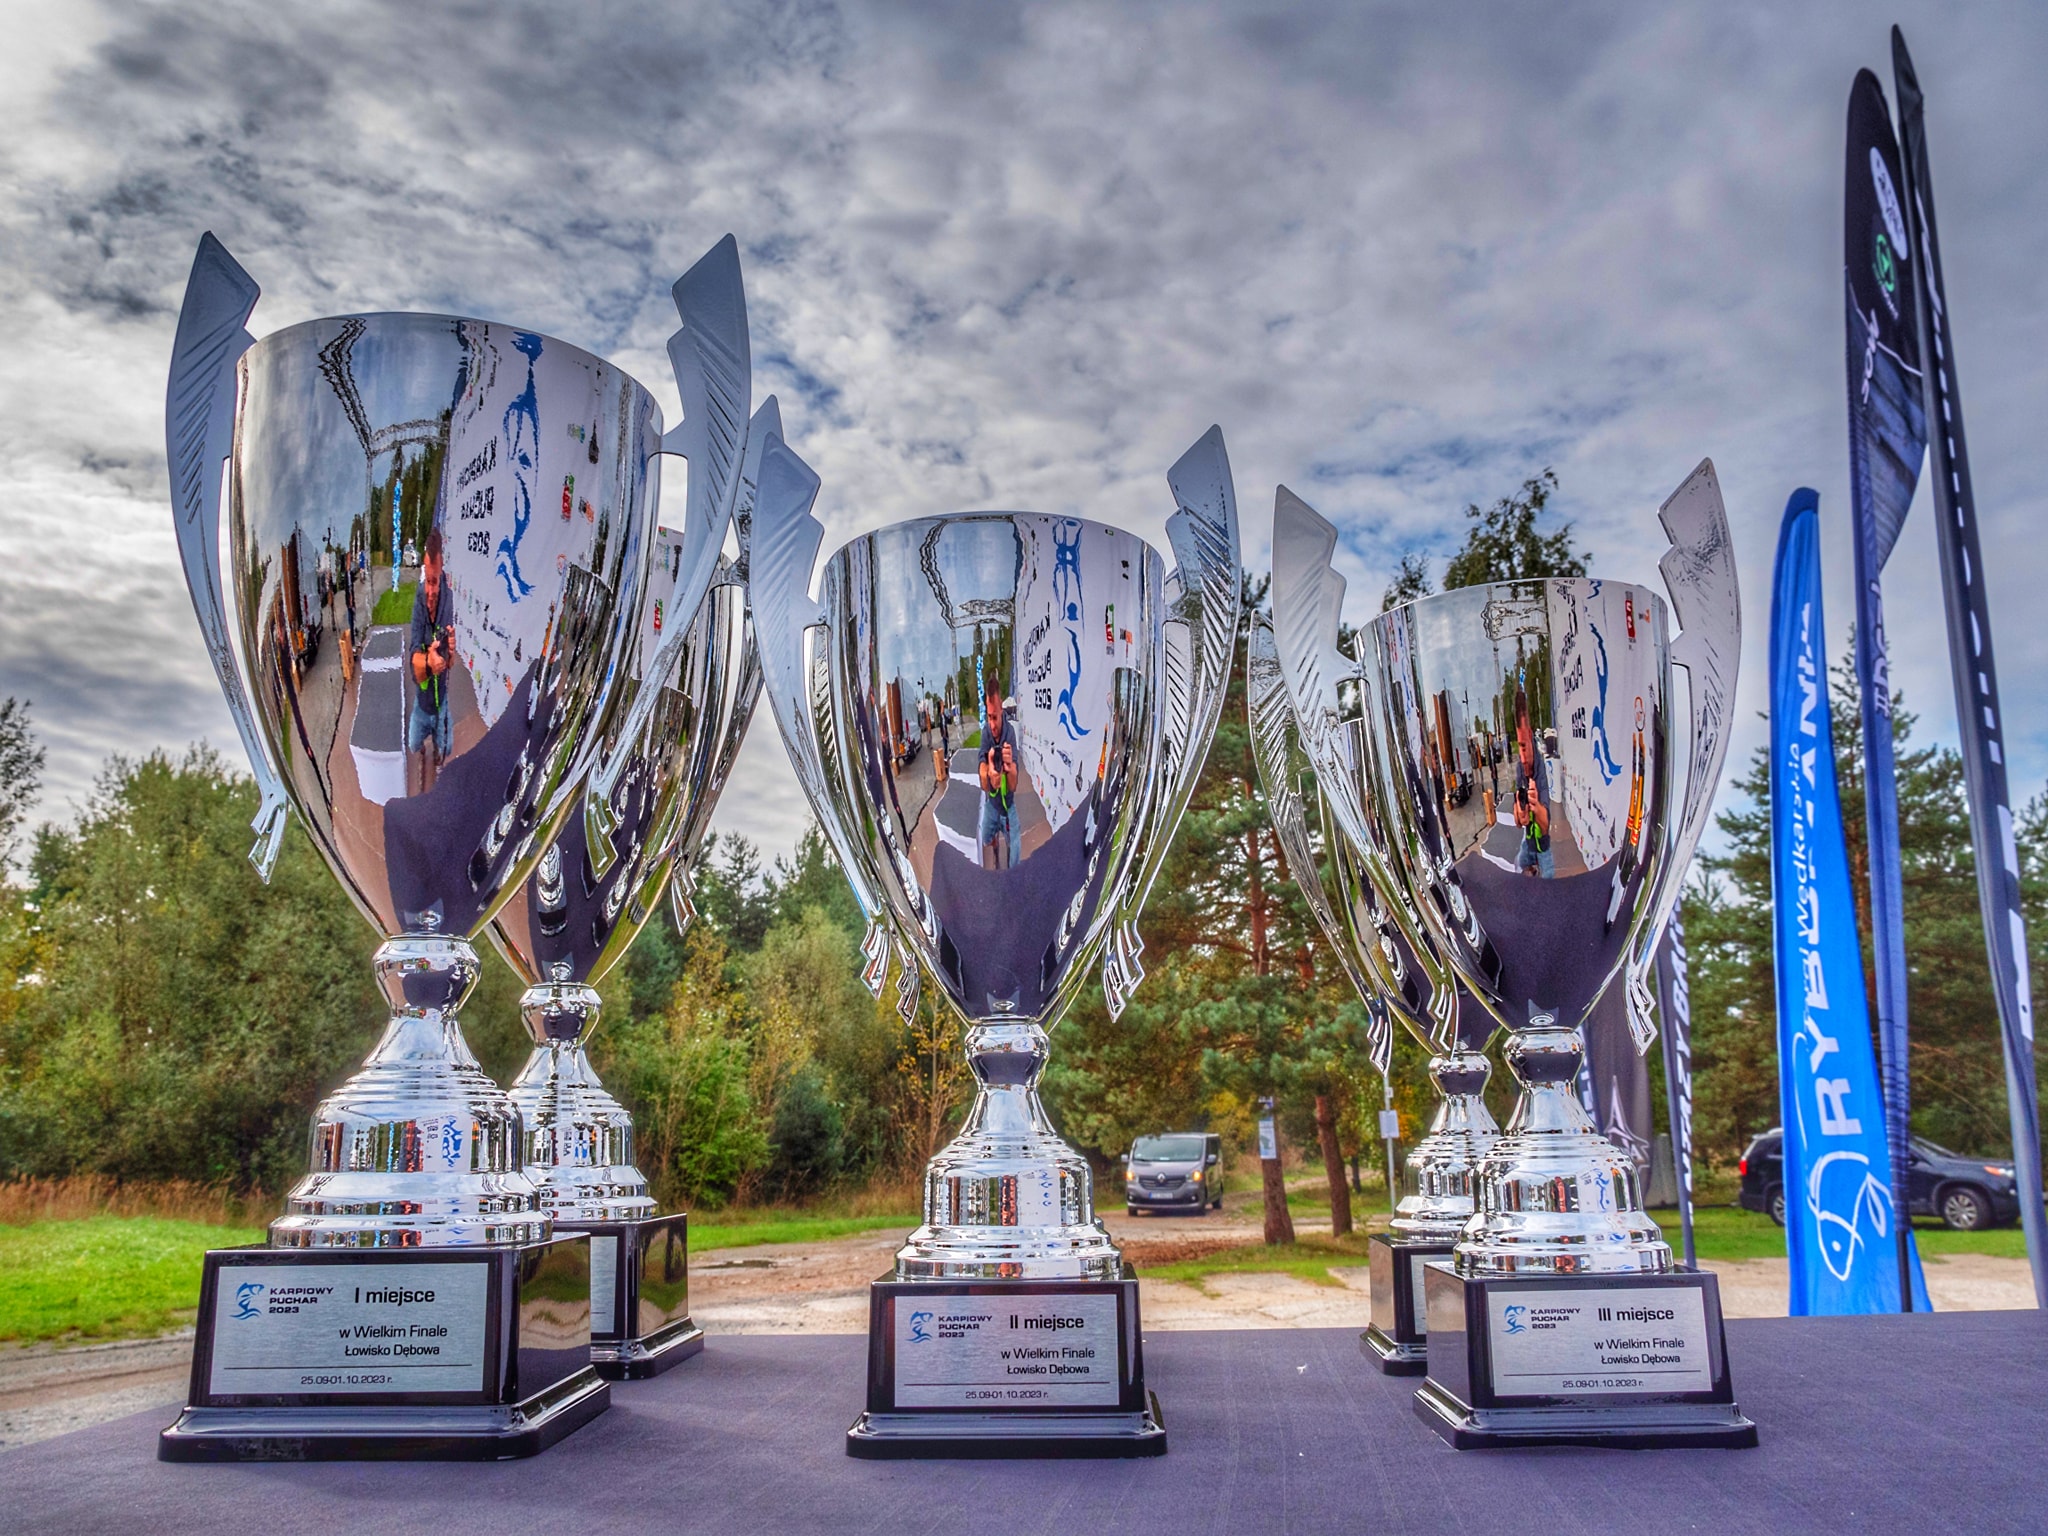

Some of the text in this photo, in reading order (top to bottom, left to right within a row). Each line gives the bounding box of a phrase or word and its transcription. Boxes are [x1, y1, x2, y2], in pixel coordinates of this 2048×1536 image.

[270, 1287, 334, 1295] KARPIOWY
[354, 1286, 435, 1306] I miejsce
[269, 1296, 318, 1304] PUCHAR
[268, 1306, 300, 1314] 2023
[1598, 1306, 1674, 1323] III miejsce
[1010, 1314, 1084, 1332] II miejsce
[339, 1325, 448, 1338] w Wielkim Finale
[1593, 1338, 1685, 1350] w Wielkim Finale
[344, 1344, 440, 1358] Łowisko Dębowa
[1001, 1347, 1095, 1359] w Wielkim Finale
[1601, 1353, 1681, 1366] Łowisko Dębowa
[1007, 1364, 1090, 1376] Łowisko Dębowa
